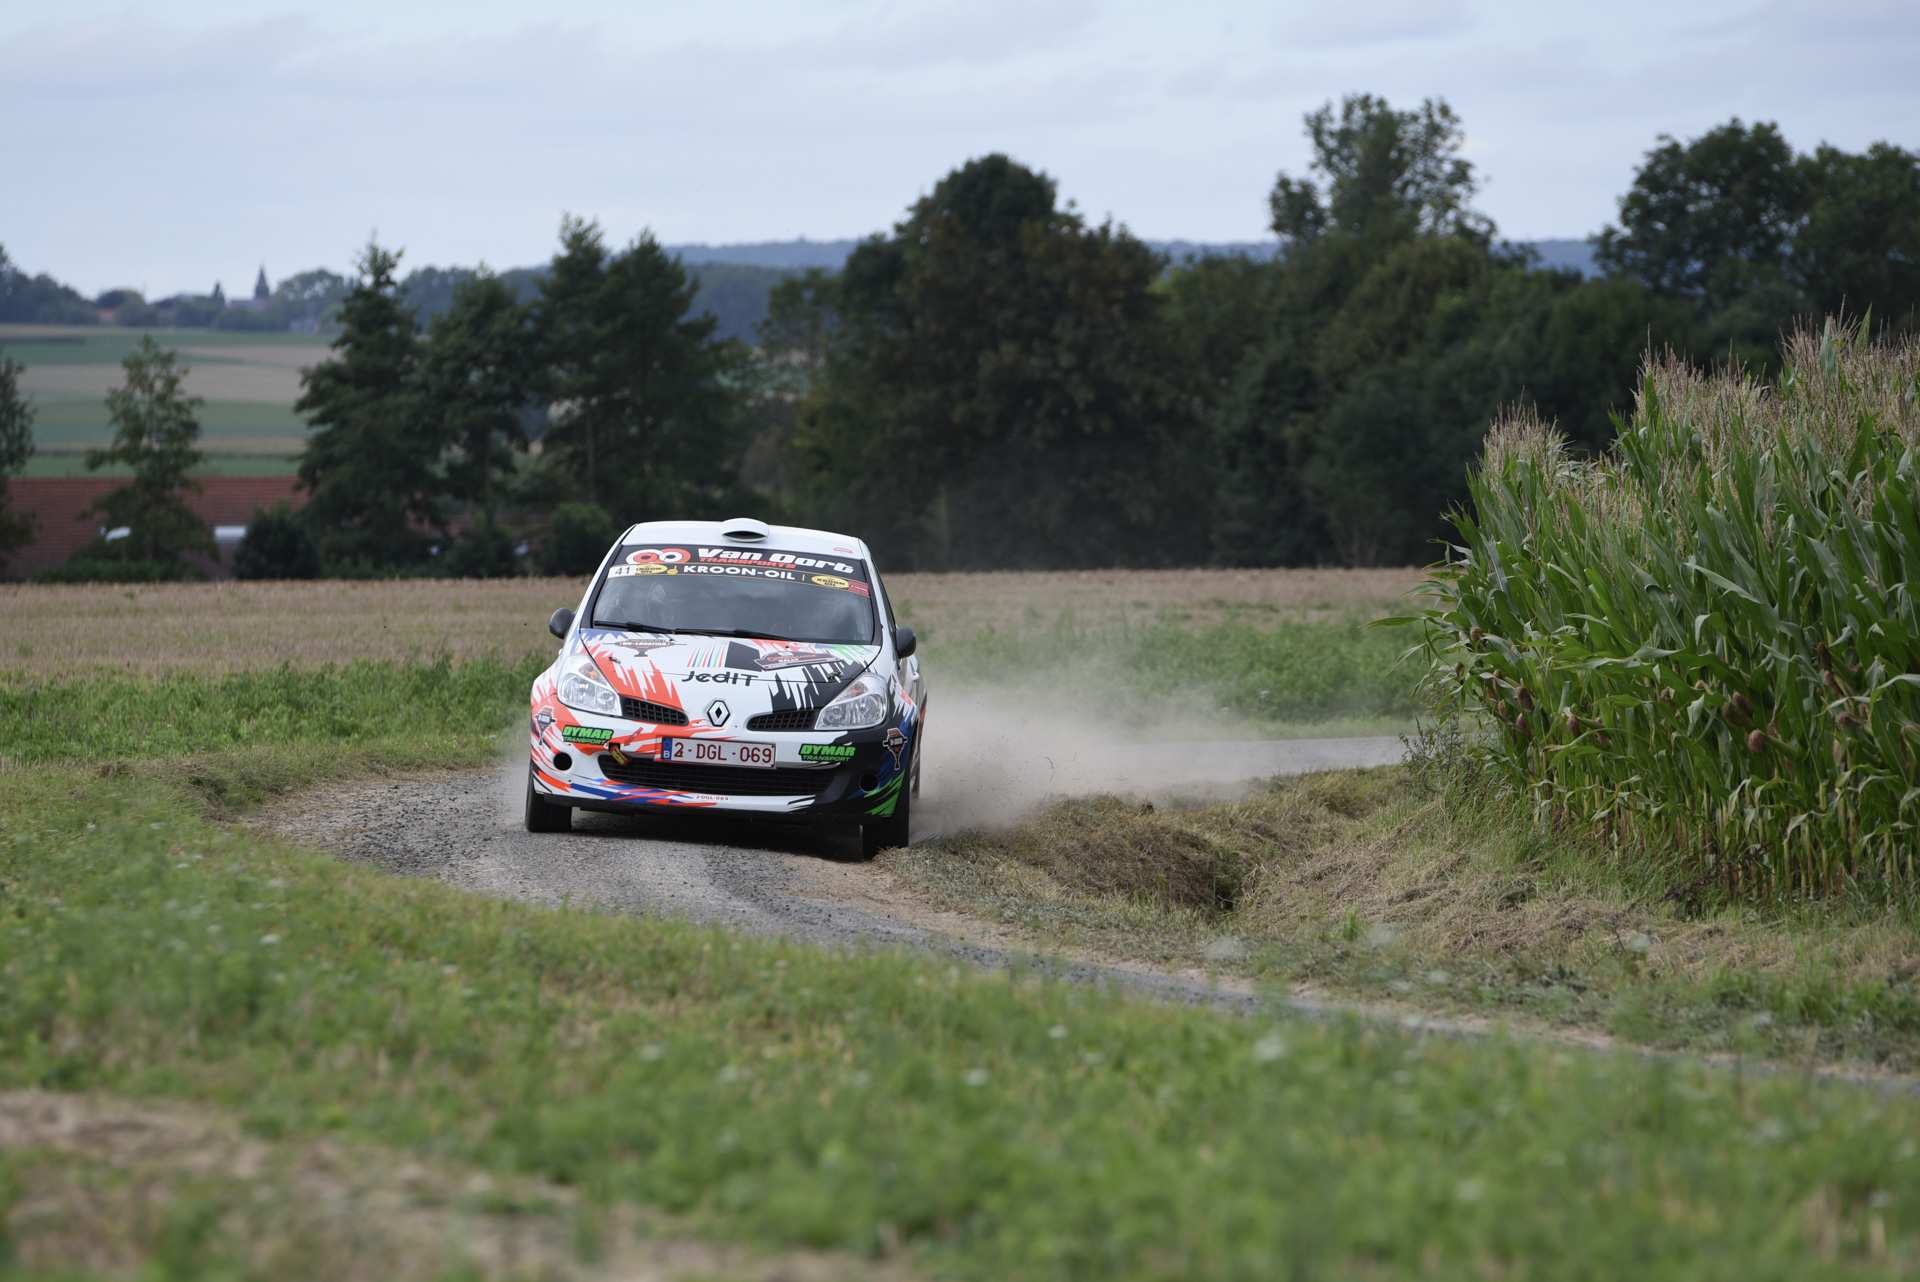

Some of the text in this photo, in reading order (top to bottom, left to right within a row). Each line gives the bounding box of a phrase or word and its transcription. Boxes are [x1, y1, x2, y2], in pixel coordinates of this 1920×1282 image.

[698, 548, 854, 574] Van Oort
[699, 557, 797, 569] TRANSPORTS
[615, 566, 631, 575] 41
[683, 565, 796, 580] KROON-OIL
[817, 578, 845, 586] KROON
[682, 670, 759, 687] JedIT
[563, 726, 614, 740] DYMAR
[564, 737, 606, 746] TRANSPORT
[663, 750, 671, 758] B
[799, 744, 856, 757] DYMAR
